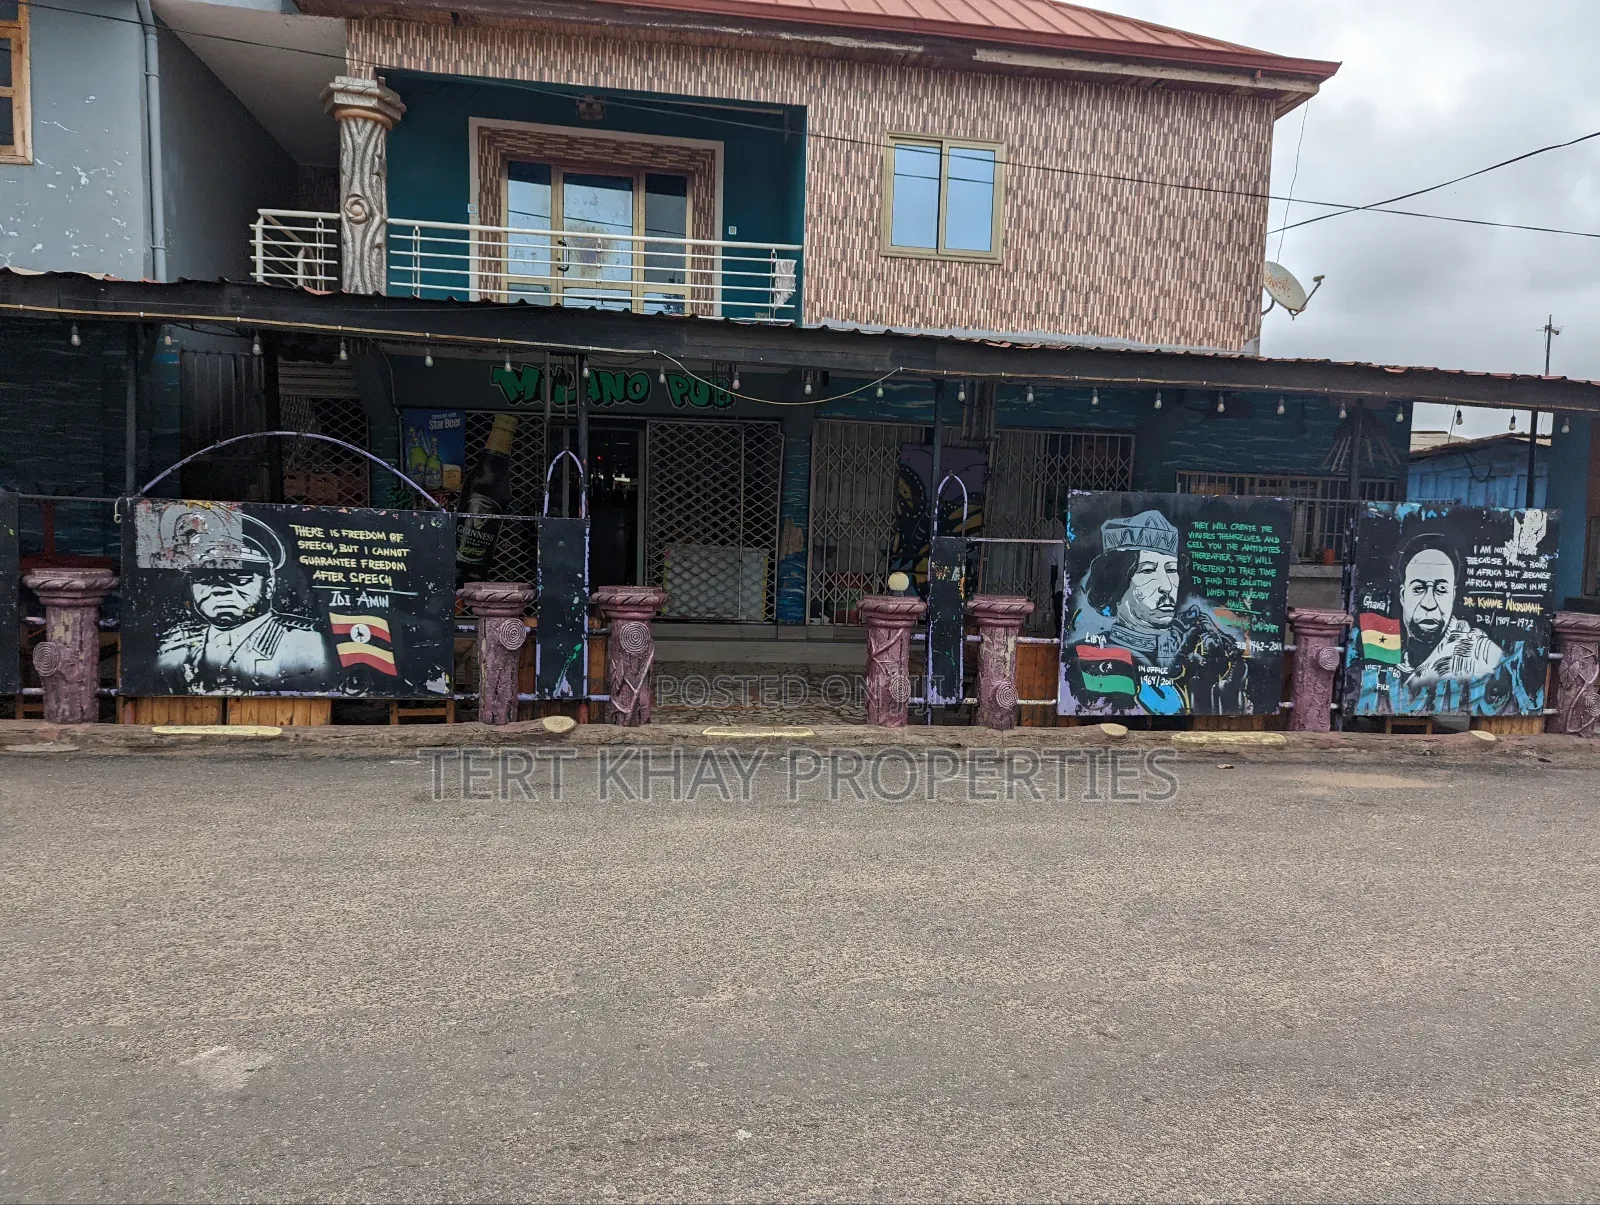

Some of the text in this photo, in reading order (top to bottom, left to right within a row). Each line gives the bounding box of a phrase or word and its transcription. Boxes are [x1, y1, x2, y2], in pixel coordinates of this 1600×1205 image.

[491, 363, 737, 409] MILANO PUB
[429, 418, 461, 430] Star Beer
[289, 524, 404, 542] THERE IS FREEDOM OF
[457, 524, 494, 541] GUINNESS
[1191, 521, 1209, 530] THEY
[1212, 521, 1227, 530] WILL
[1230, 523, 1257, 532] CREATE
[1188, 531, 1280, 544] VIRUSES THEMSELVES AND
[297, 540, 411, 557] SPEECH, BUT I CANNOT
[1186, 540, 1204, 549] SELL
[1208, 542, 1222, 550] YOU
[1226, 543, 1239, 551] THE
[1480, 545, 1491, 554] AM
[299, 555, 407, 571] GUARANTEE FREEDOM
[1234, 554, 1252, 564] THEY
[1255, 556, 1273, 565] WILL
[1465, 556, 1503, 566] BECAUSE
[1529, 560, 1549, 570] BORN
[1192, 561, 1277, 578] PRETEND TO TAKE TIME
[1467, 567, 1552, 580] IN AFRICA BUT BECAUSE
[312, 570, 393, 586] AFTER SPEECH
[1191, 575, 1272, 587] TO FIND THE SOLUTION
[1465, 578, 1492, 588] AFRICA
[1494, 580, 1508, 589] WAS
[1510, 581, 1527, 590] BORN
[1529, 583, 1537, 591] IN
[329, 591, 389, 608] IDI AMIN
[1206, 588, 1226, 597] WHEN
[1241, 589, 1270, 600] ALREADY
[1227, 599, 1245, 609] HAVE
[1477, 597, 1503, 609] KWAME
[1085, 632, 1107, 644] LIBYA
[1138, 665, 1169, 675] IN OFFICE
